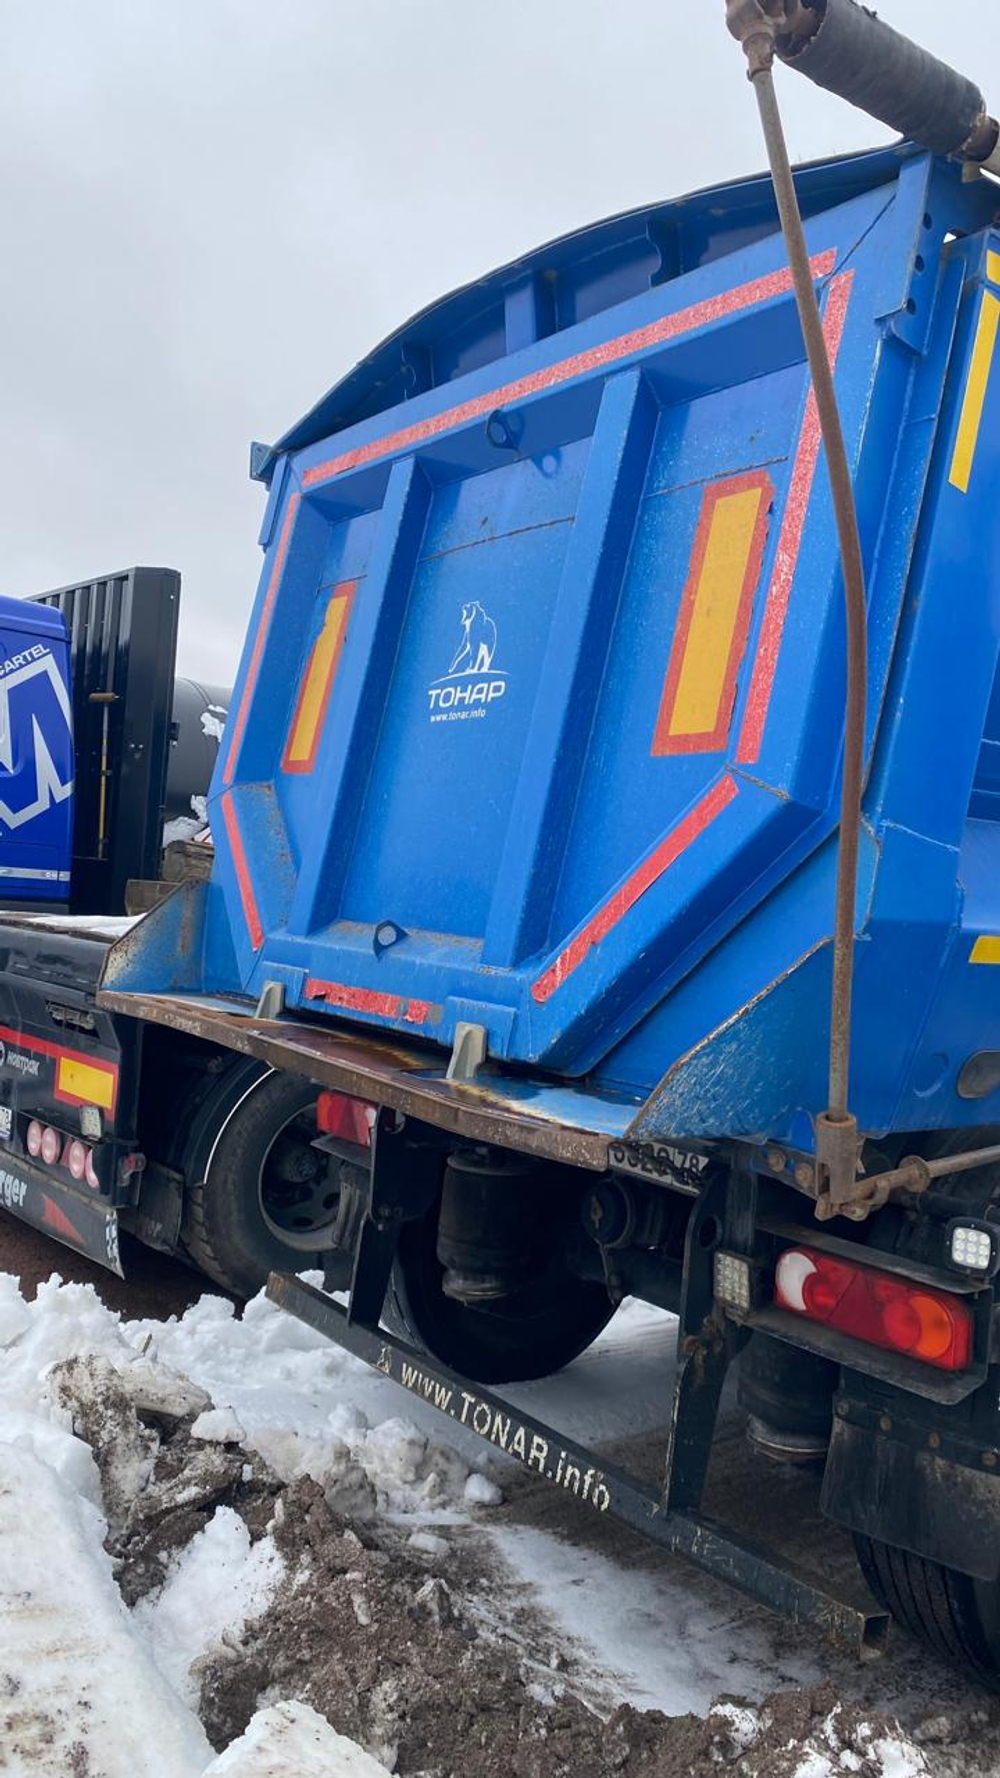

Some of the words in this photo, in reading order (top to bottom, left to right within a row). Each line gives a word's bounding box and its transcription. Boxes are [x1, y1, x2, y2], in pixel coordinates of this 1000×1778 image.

[428, 680, 506, 709] ТОНАР
[430, 707, 486, 723] www.tonar.info
[400, 1362, 610, 1512] www.TONAR.info
